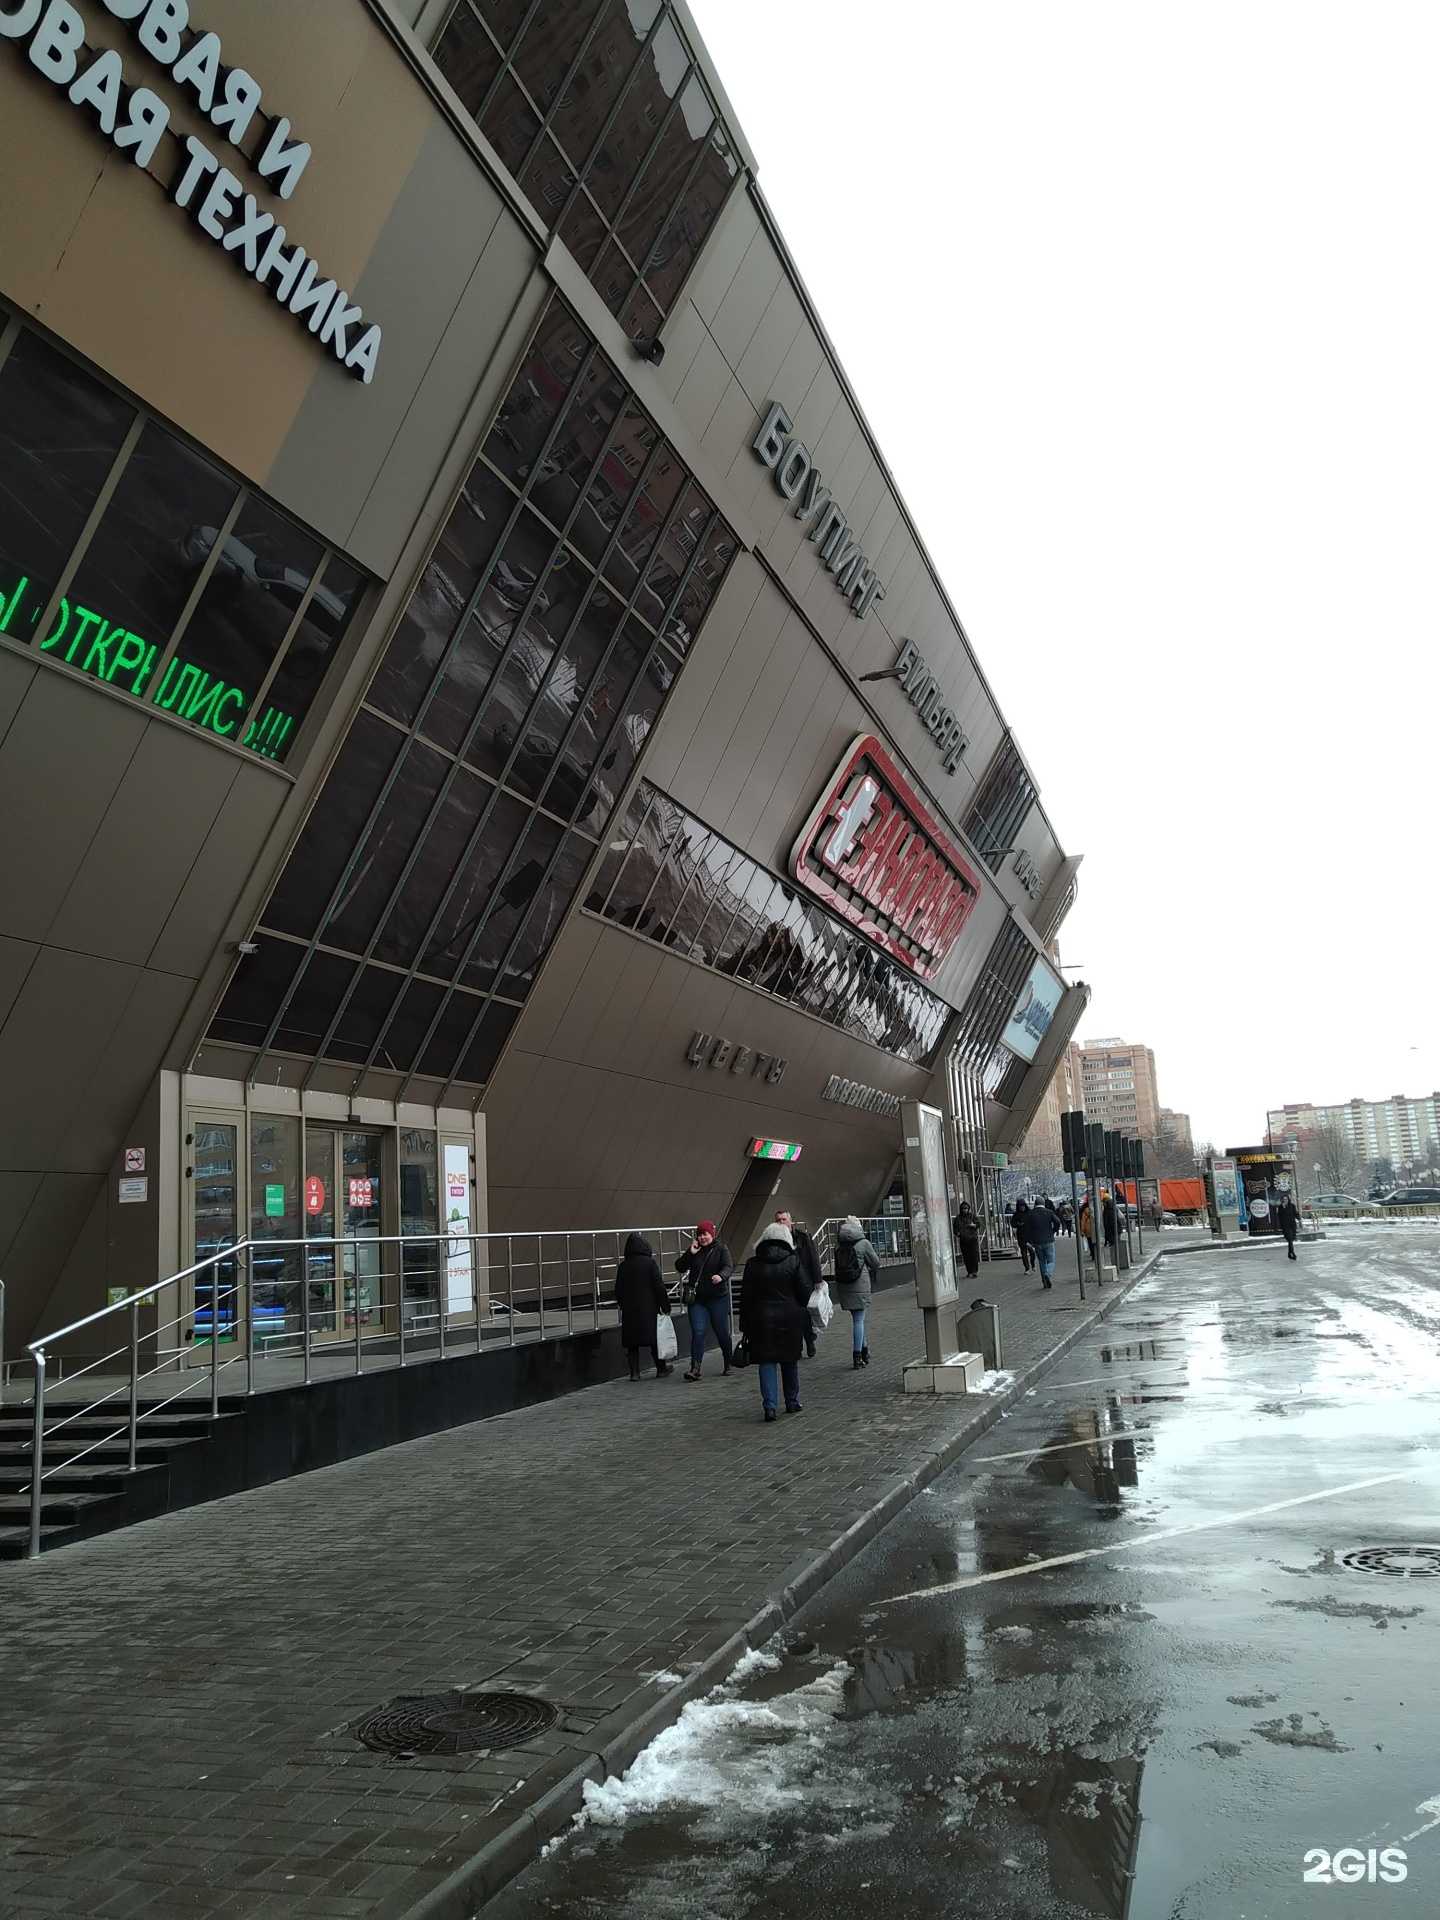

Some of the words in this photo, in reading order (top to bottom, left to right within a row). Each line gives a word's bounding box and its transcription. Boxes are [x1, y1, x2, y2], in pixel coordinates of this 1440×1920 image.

[104, 0, 262, 145] ВАЯ
[258, 117, 312, 200] И
[175, 135, 382, 385] ТЕХНИКА
[752, 401, 888, 620] БОУЛИНГ
[894, 638, 971, 777] БИЛЬЯРД
[686, 1031, 789, 1085] ЦВЕТЫ
